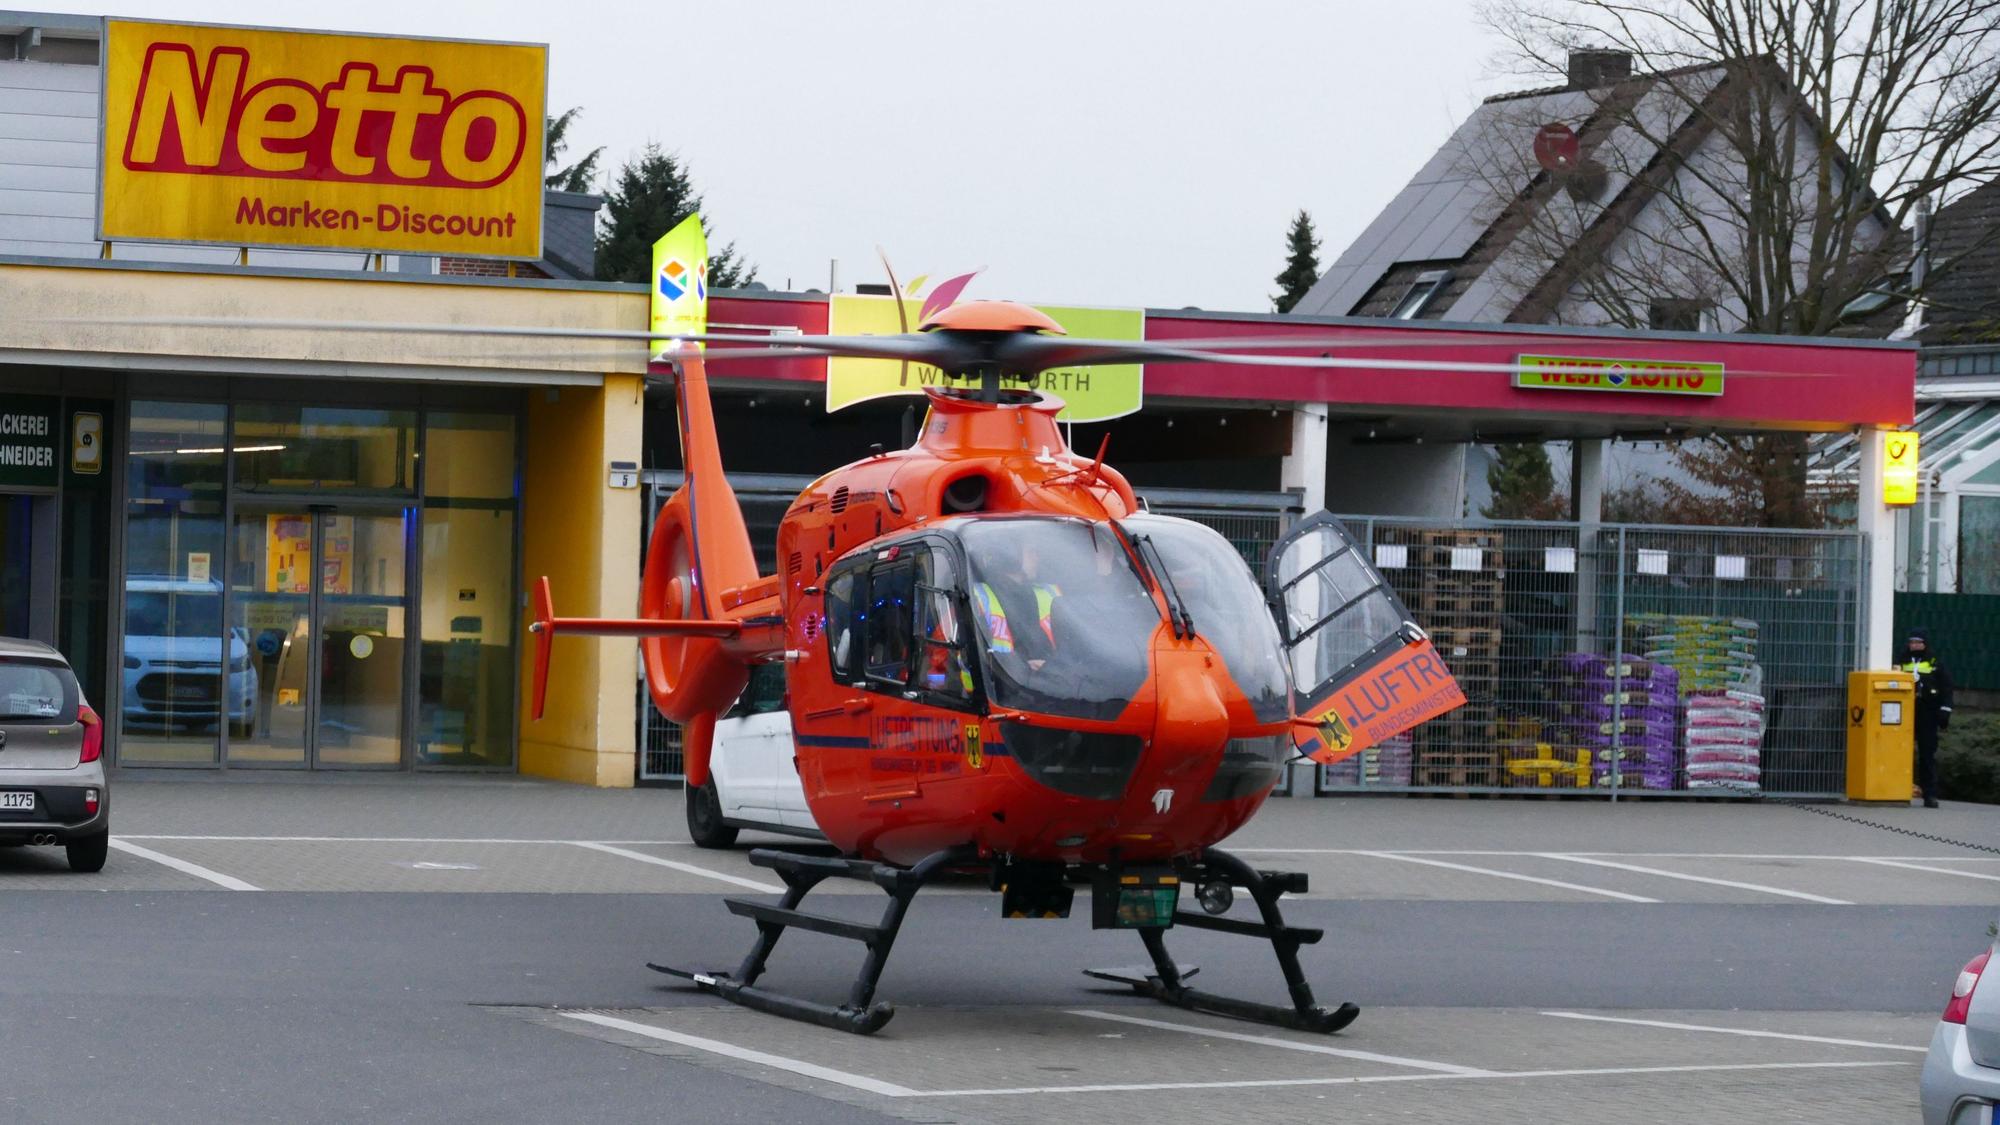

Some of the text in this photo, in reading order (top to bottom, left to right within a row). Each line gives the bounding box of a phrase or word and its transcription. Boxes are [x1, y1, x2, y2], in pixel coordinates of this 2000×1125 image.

[122, 42, 527, 189] Netto
[236, 197, 516, 238] Marken-Discount
[1538, 361, 1704, 389] WEST LOTTO
[0, 414, 48, 436] CKEREI
[622, 474, 628, 487] 5
[4, 793, 33, 807] 1175
